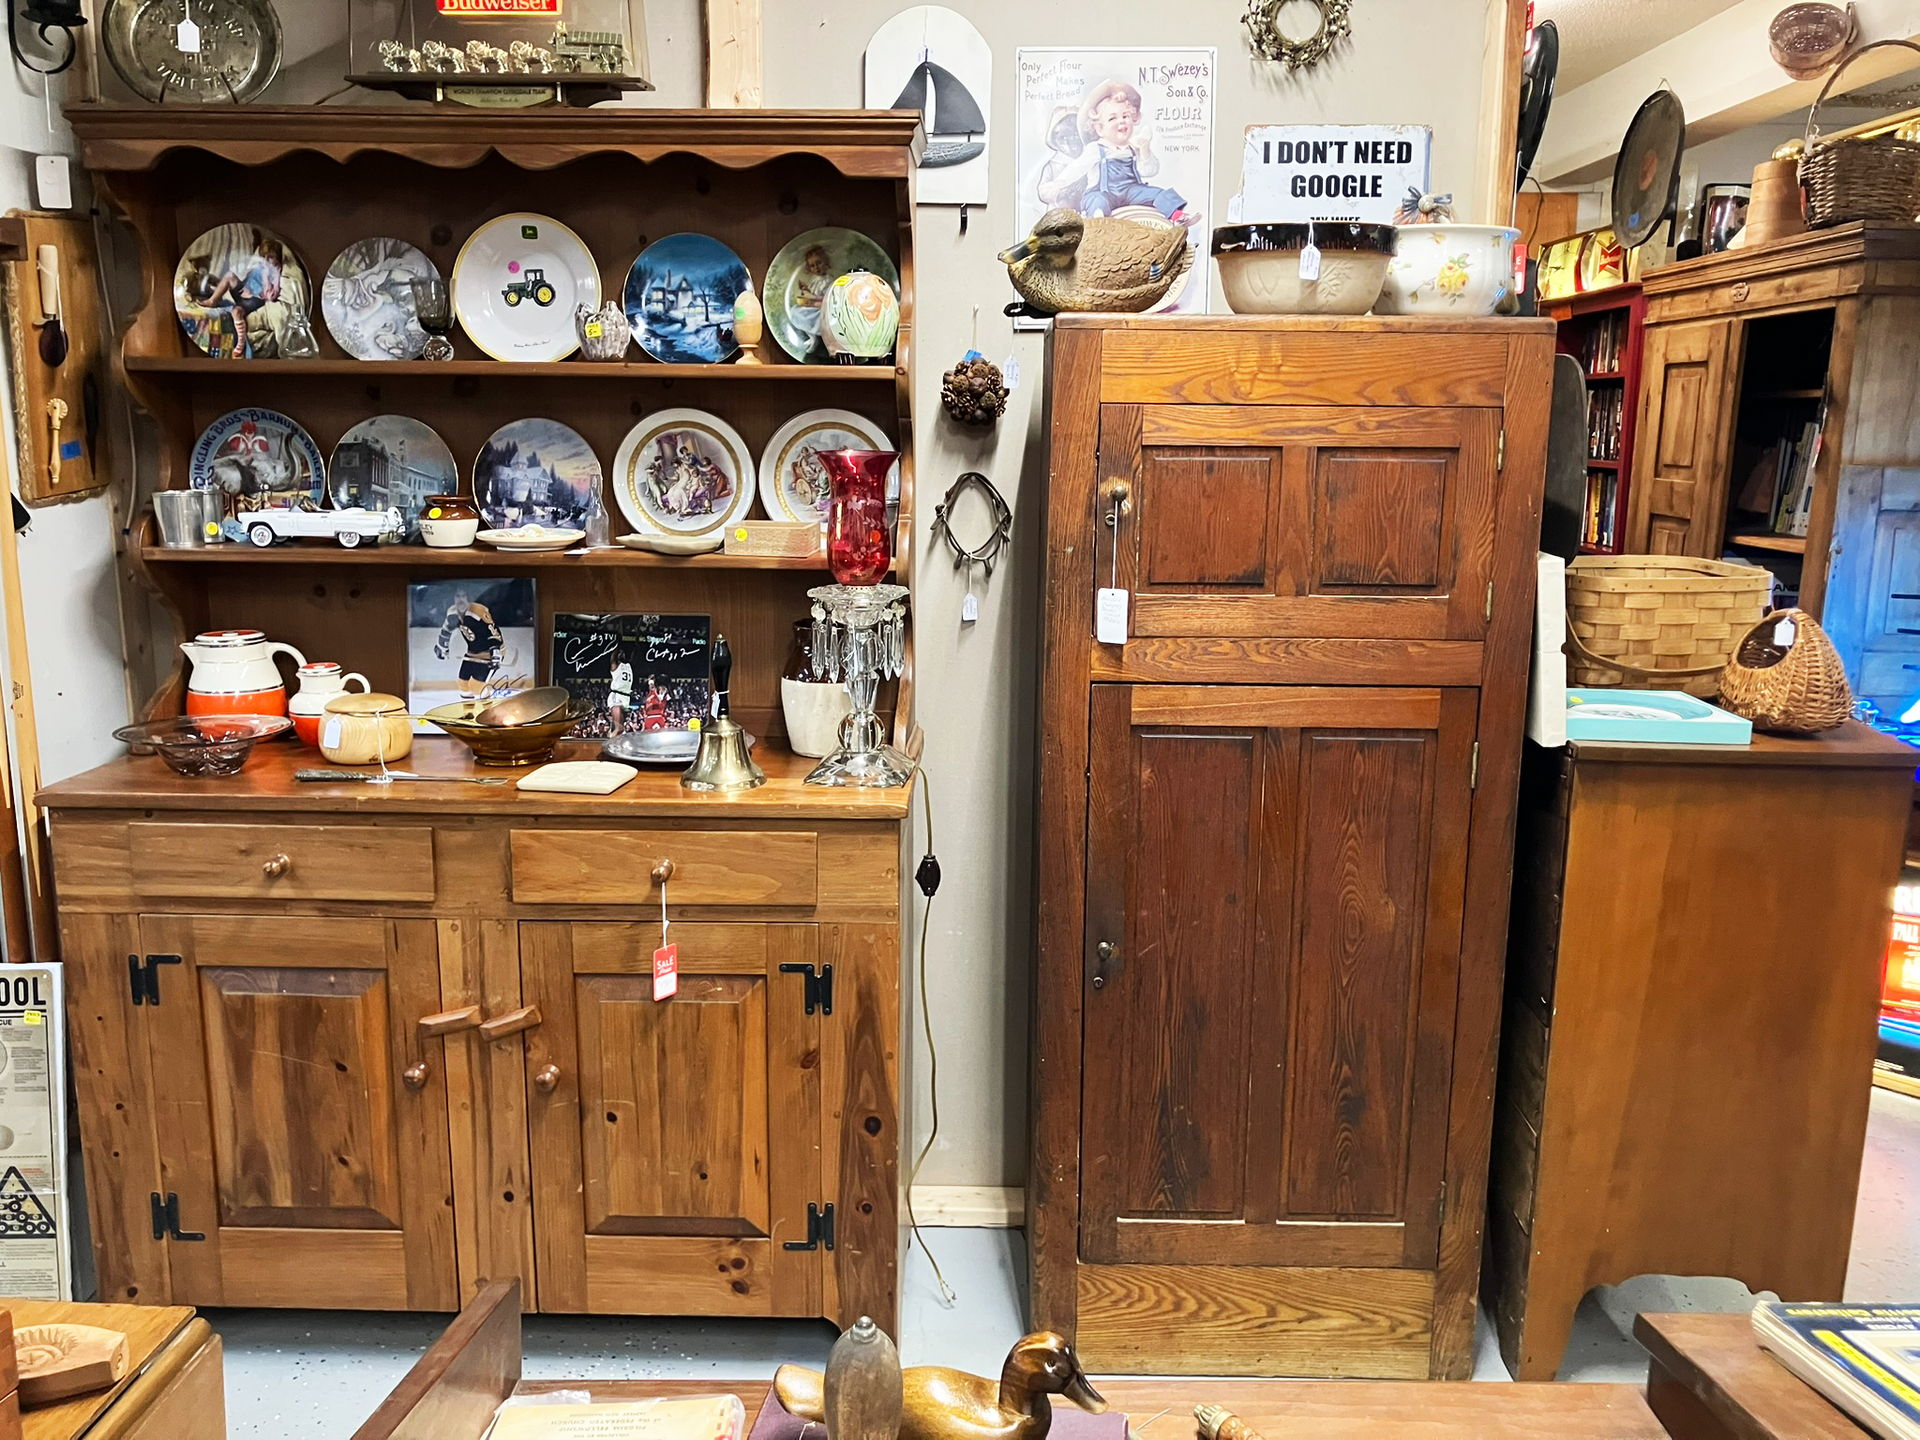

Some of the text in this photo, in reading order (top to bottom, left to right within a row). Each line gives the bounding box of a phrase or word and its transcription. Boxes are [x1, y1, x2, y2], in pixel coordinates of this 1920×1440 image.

[443, 0, 551, 10] Budweiser
[1021, 59, 1083, 87] Only Perfect Flour
[1160, 63, 1209, 85] Swezey's
[1056, 77, 1085, 87] Makes
[1025, 87, 1081, 102] Perfect Bread
[1166, 85, 1209, 104] Son & Co.
[1155, 107, 1202, 121] FLOUR
[1181, 145, 1200, 153] YORK
[1263, 141, 1412, 164] I DON'T NEED
[1291, 175, 1383, 198] GOOGLE
[656, 955, 674, 970] SALE
